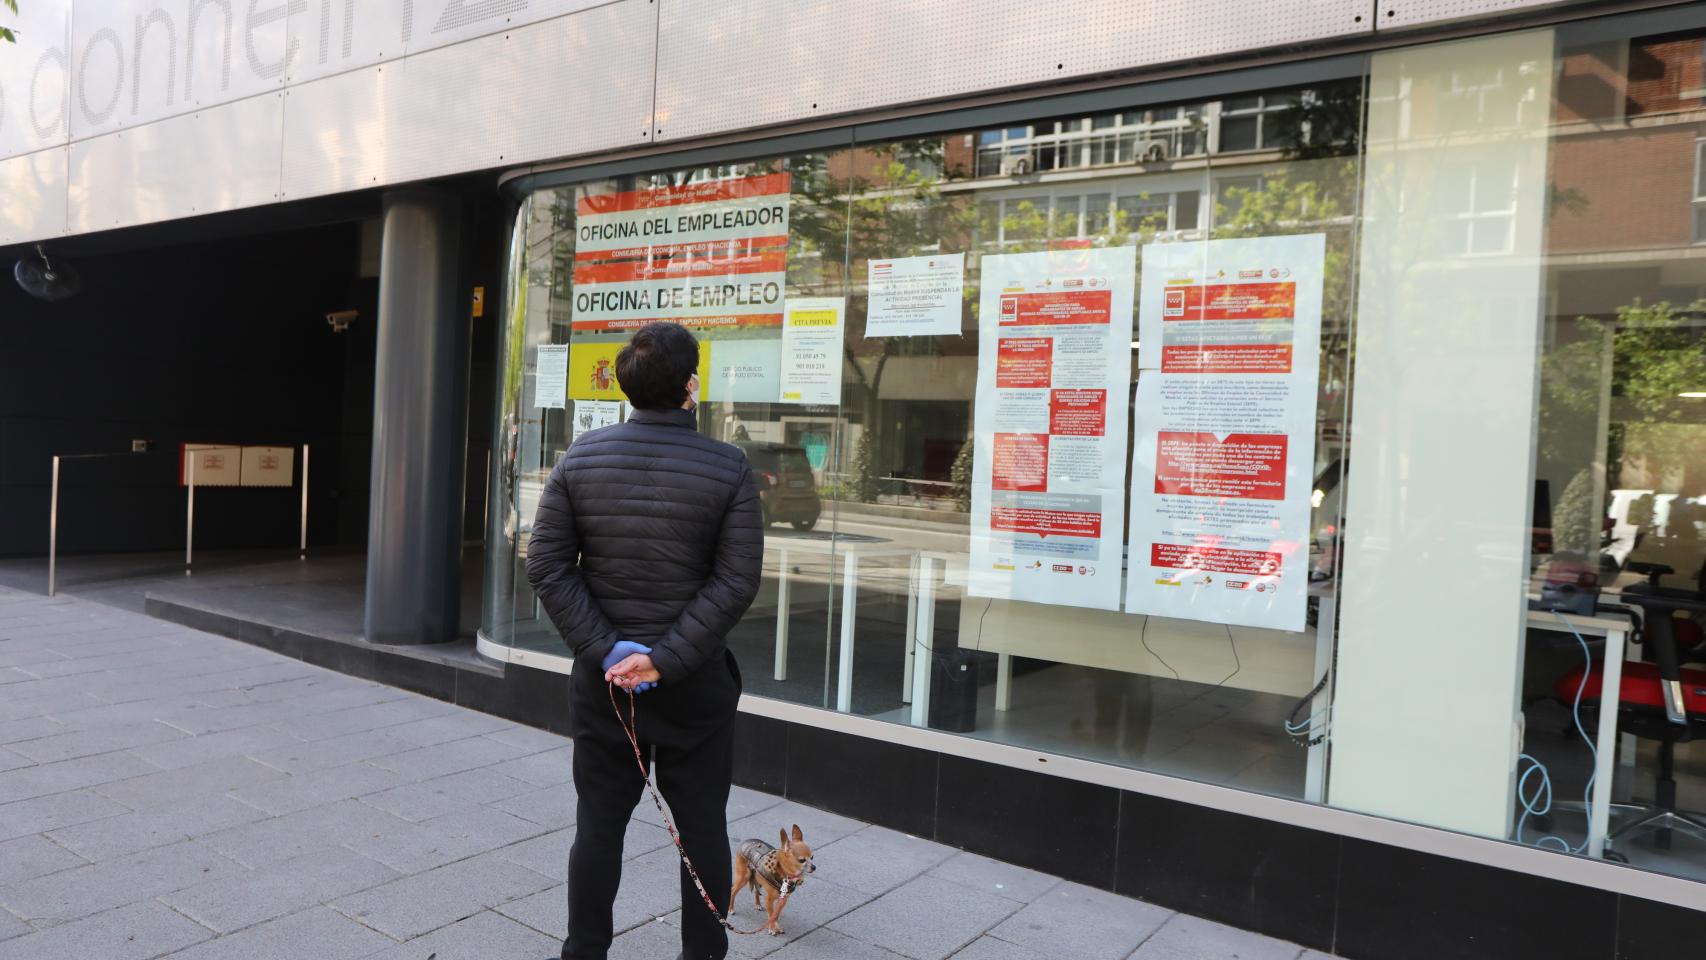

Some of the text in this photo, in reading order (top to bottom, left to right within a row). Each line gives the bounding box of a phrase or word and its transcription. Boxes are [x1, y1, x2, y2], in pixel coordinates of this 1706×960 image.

[580, 206, 784, 241] OFICINA DEL EMPLEADOR
[577, 282, 780, 312] OFICINA DE EMPLEO
